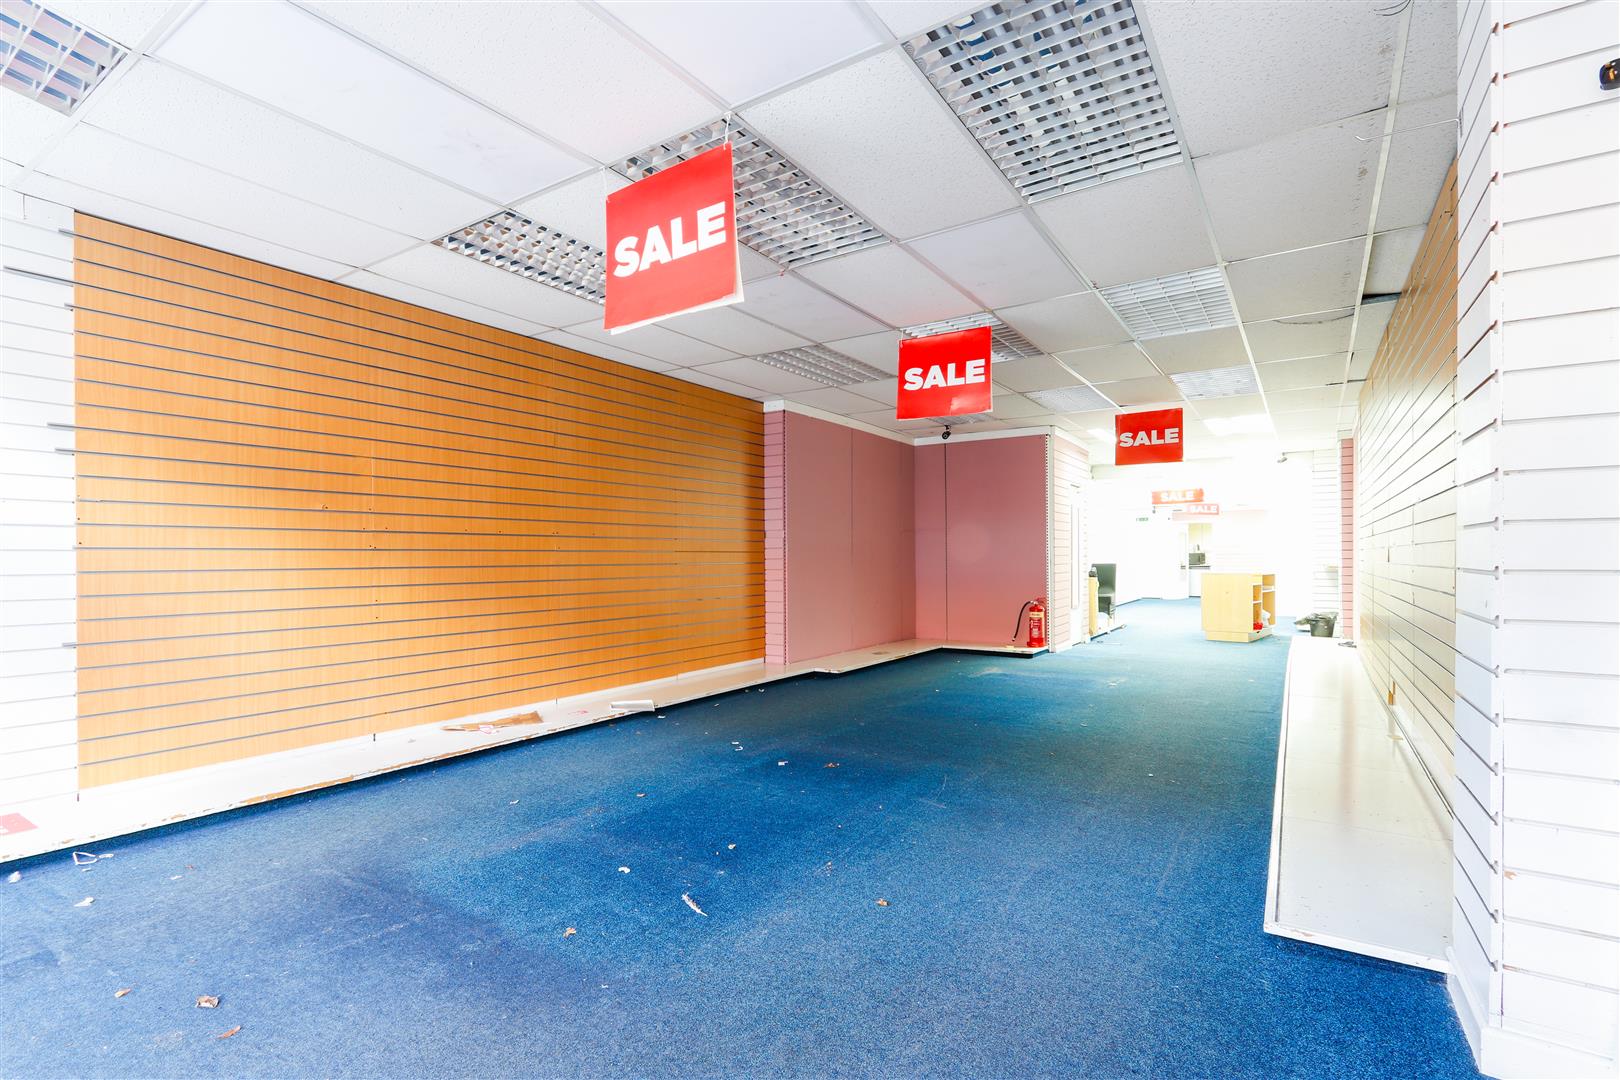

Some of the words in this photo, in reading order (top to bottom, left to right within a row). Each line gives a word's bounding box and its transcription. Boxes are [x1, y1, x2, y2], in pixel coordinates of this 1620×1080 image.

[613, 201, 726, 277] SALE
[903, 358, 985, 390] SALE
[1119, 427, 1180, 448] SALE
[1160, 490, 1194, 502] SALE
